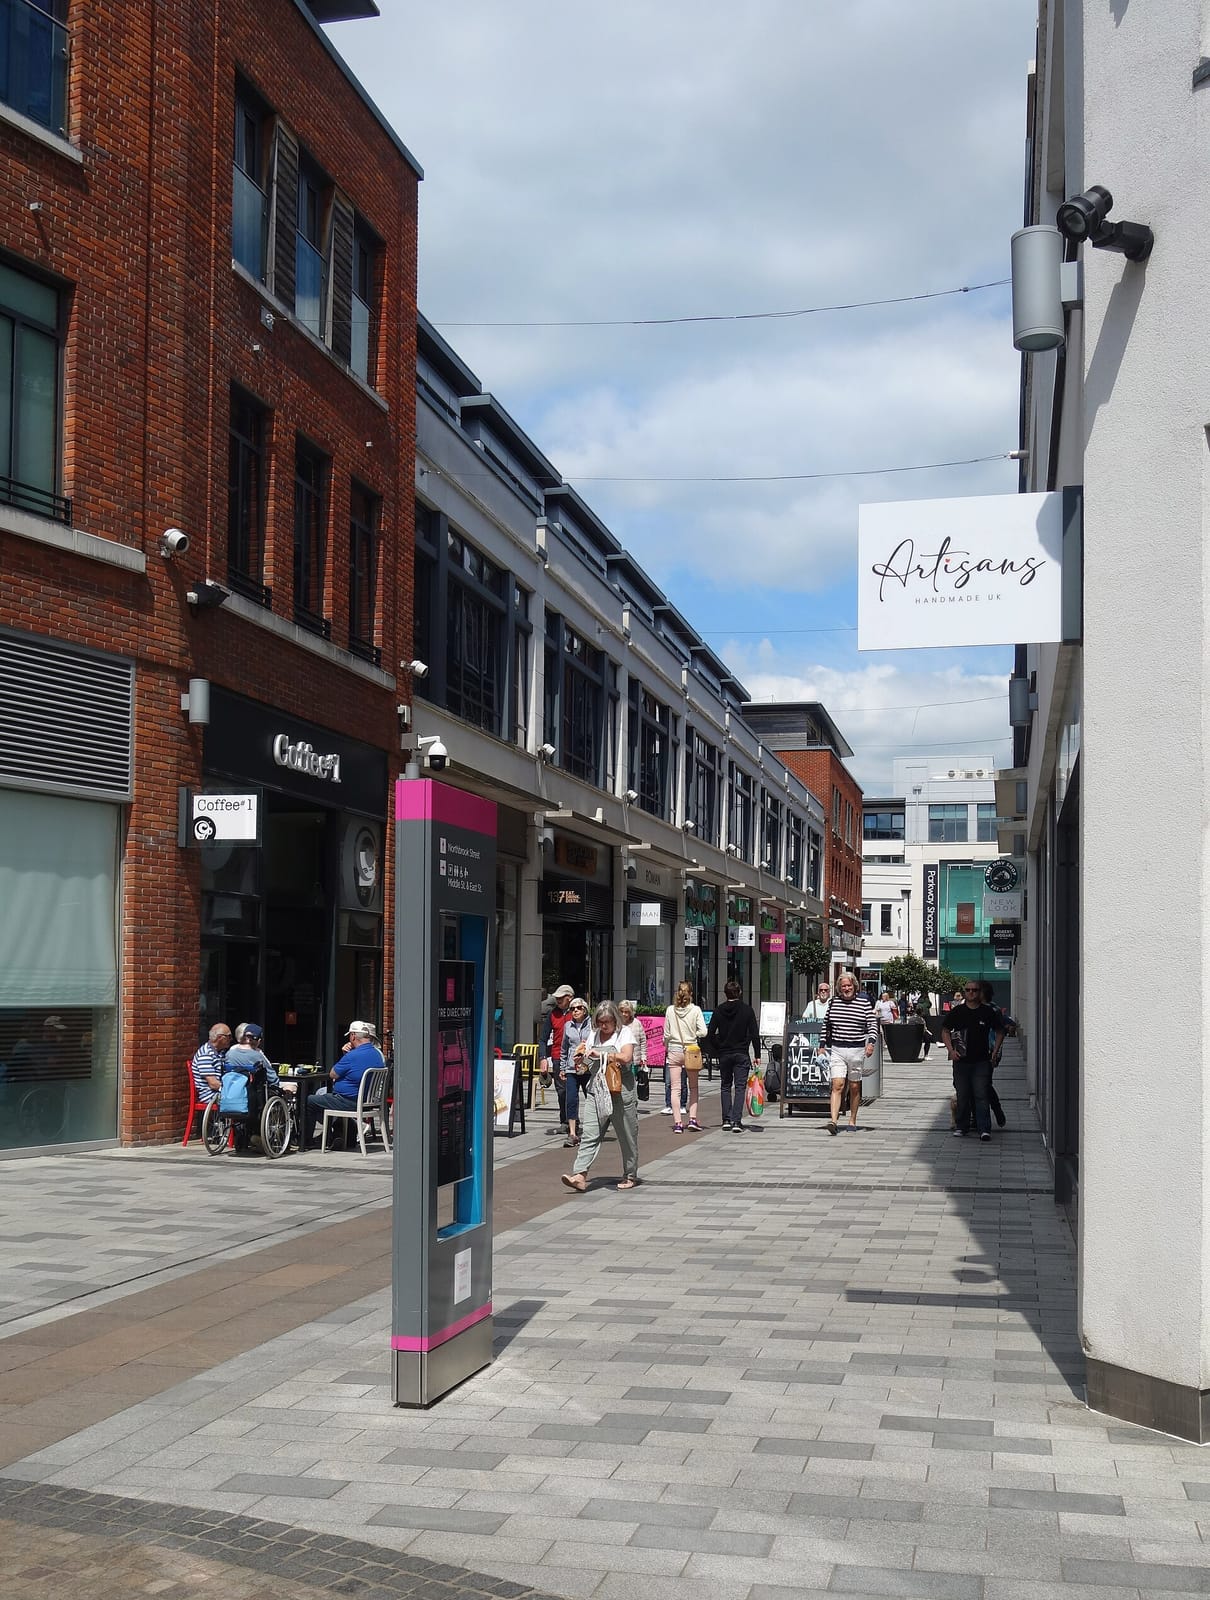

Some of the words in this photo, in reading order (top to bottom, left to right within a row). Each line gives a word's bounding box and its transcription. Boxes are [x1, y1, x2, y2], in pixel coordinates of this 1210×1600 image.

[872, 536, 1046, 602] Artisans
[915, 595, 980, 604] HANDMADE
[448, 843, 469, 856] Northbrook
[469, 849, 480, 860] Street
[645, 868, 661, 887] ROMAN
[985, 866, 993, 876] THE
[1006, 862, 1017, 876] SHOP
[447, 878, 460, 888] Middle
[926, 870, 936, 905] Parkway
[925, 906, 936, 945] Shopping
[447, 1007, 472, 1017] DIRECTORY
[791, 1047, 810, 1065] WE
[790, 1064, 831, 1082] OPEN
